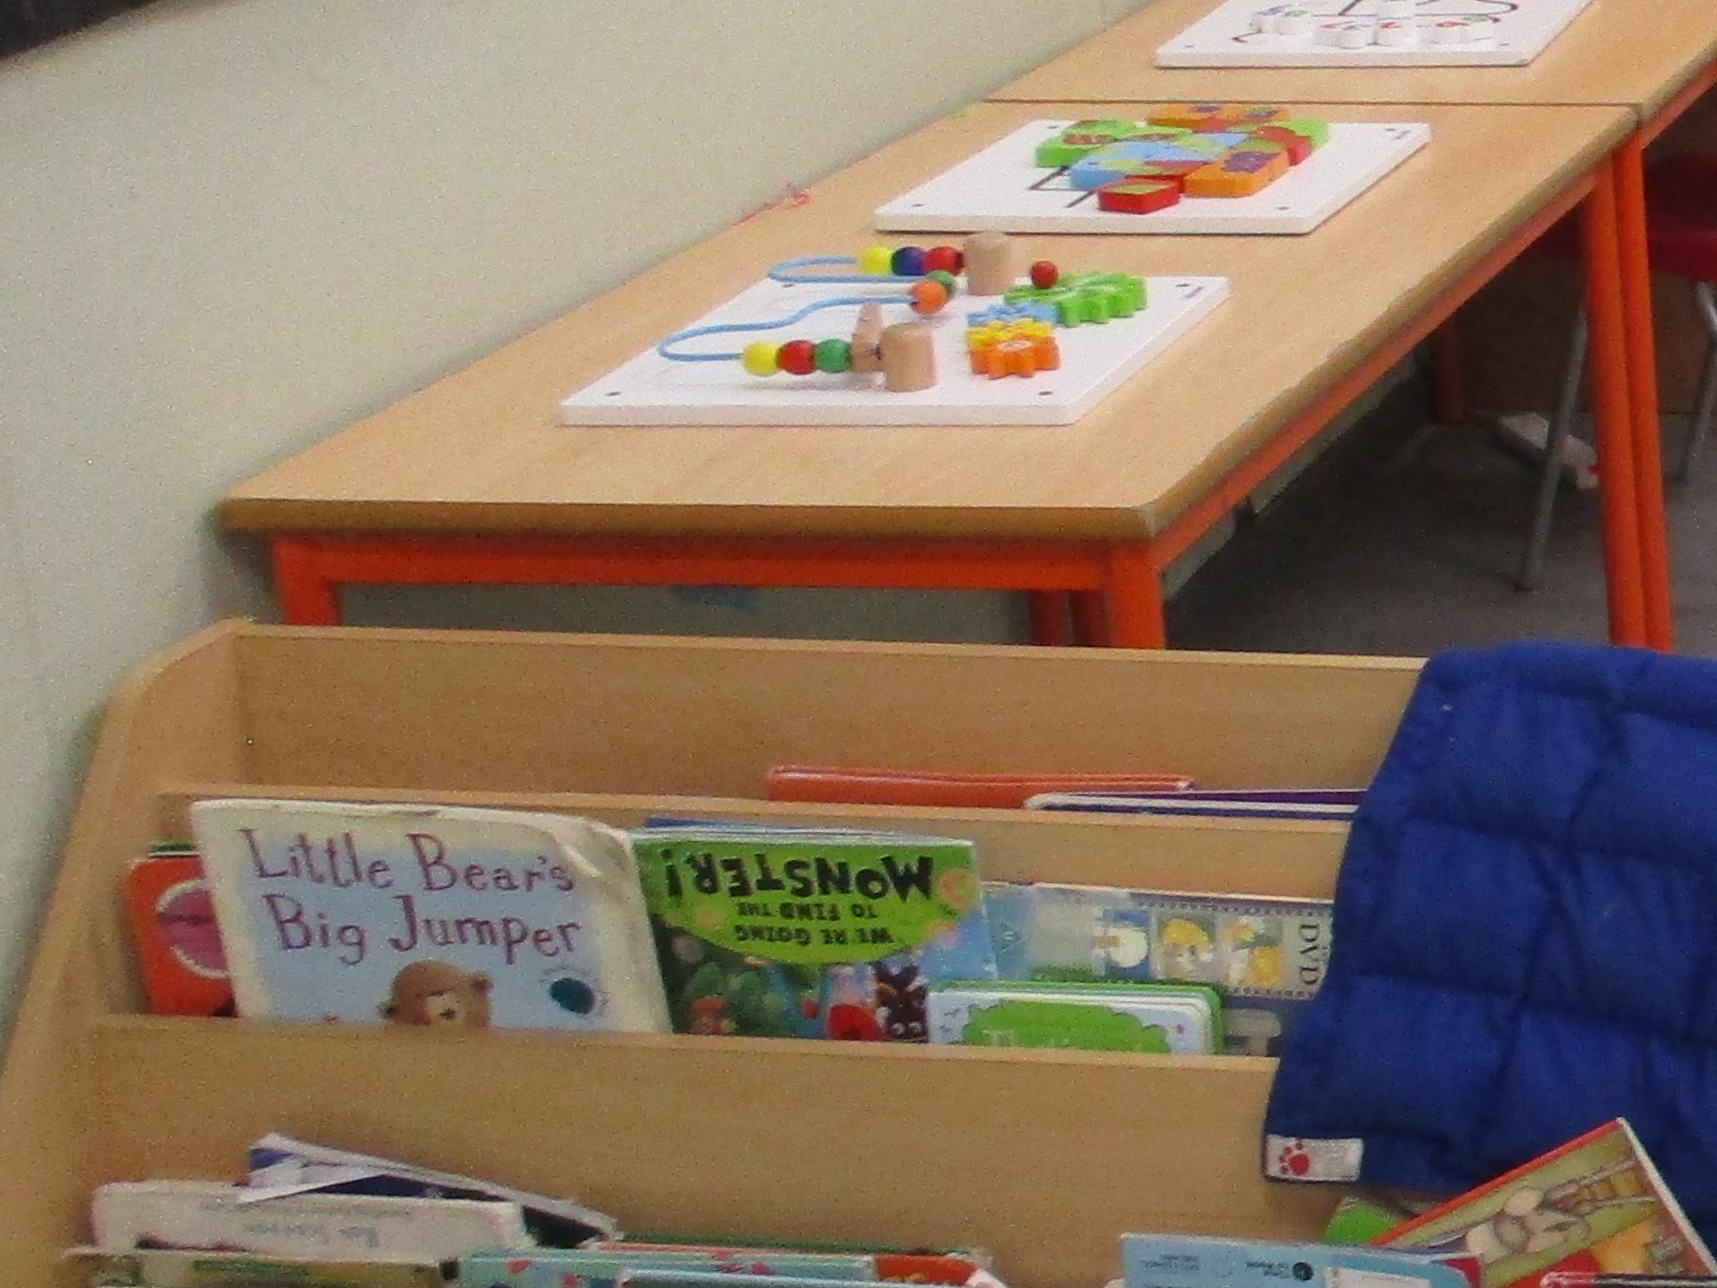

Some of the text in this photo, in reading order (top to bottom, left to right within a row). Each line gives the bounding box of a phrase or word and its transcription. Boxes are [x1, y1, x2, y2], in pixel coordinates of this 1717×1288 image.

[237, 826, 575, 893] Little Bear's
[660, 849, 934, 904] MONSTER!
[262, 892, 583, 966] Big Jumper
[733, 924, 812, 946] GOING
[780, 902, 841, 921] FIND
[850, 903, 879, 919] TO
[1298, 922, 1321, 990] DVD
